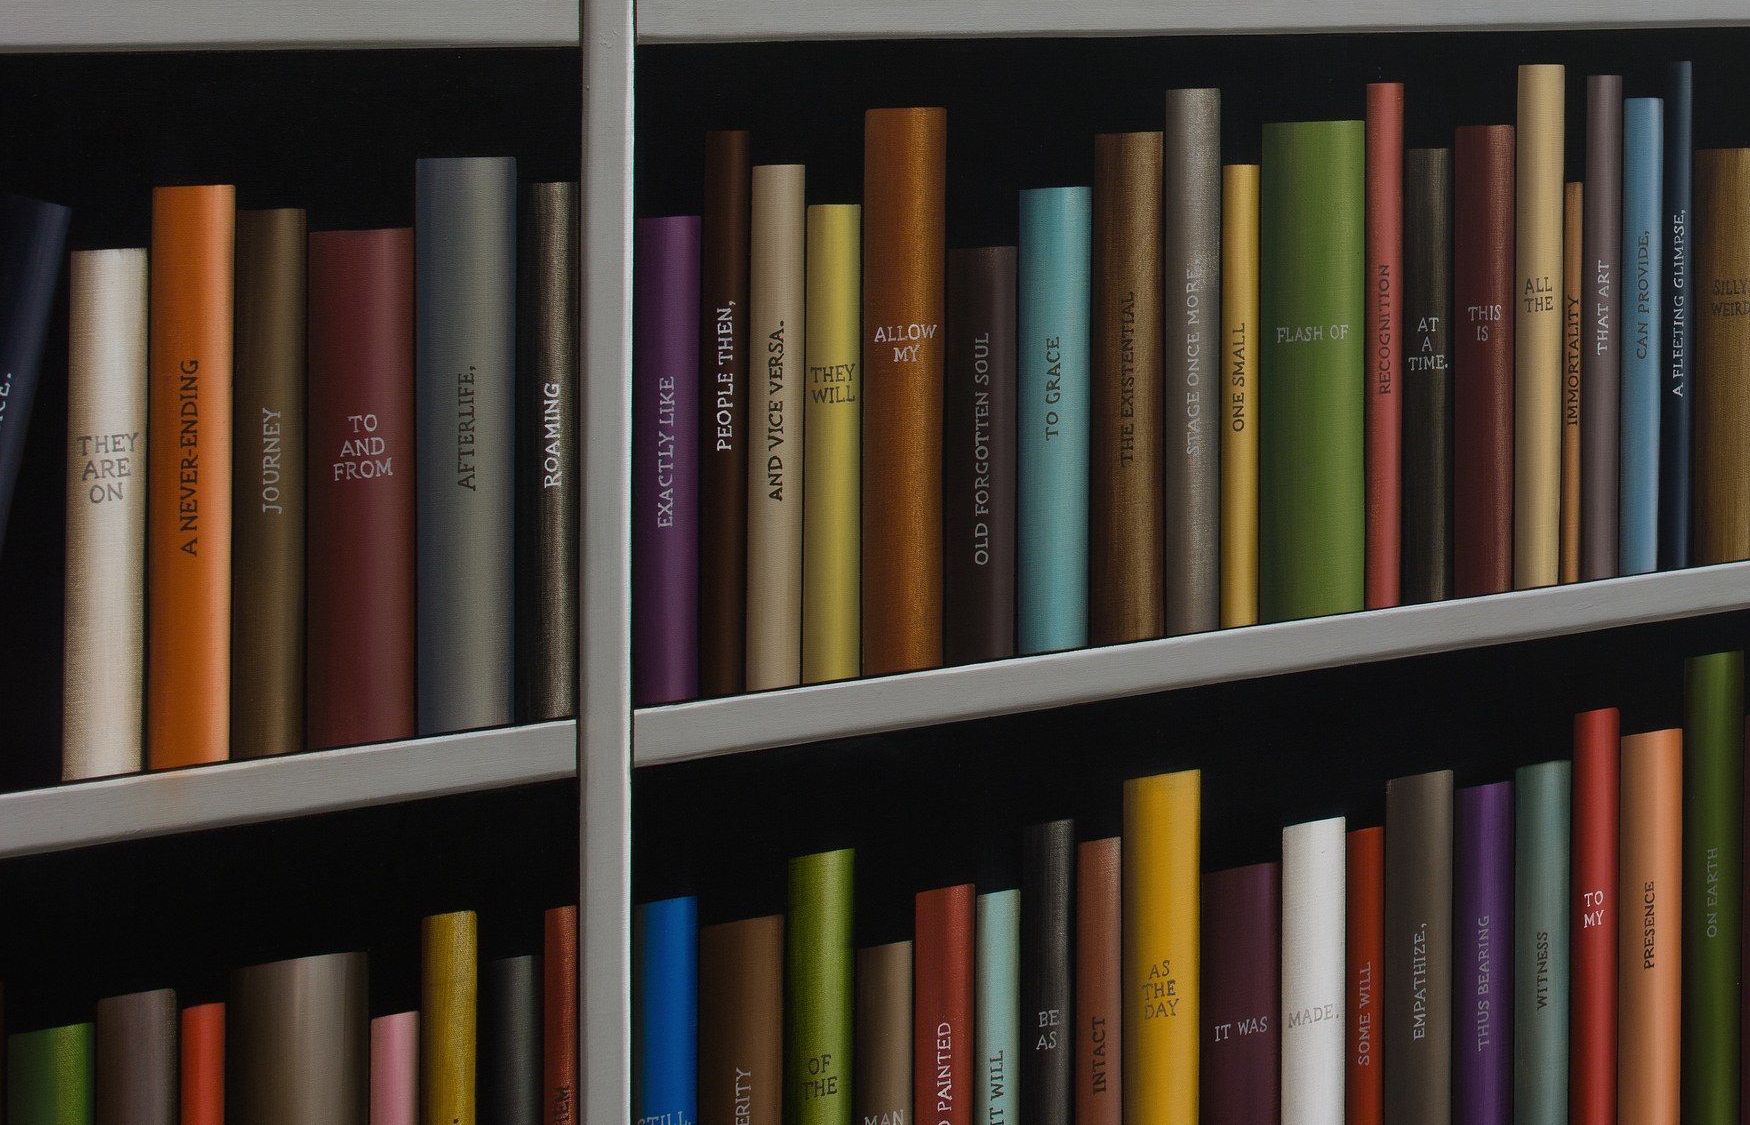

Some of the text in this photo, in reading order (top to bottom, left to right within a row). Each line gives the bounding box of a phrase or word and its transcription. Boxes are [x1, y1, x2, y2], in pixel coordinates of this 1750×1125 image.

[1673, 209, 1686, 397] A FLEETING GLIMPSE,
[874, 324, 936, 343] ALLOW
[893, 345, 920, 362] MY
[717, 300, 735, 451] PEOPLE THEN,
[810, 364, 856, 383] THEY
[811, 385, 856, 404] WILL
[768, 320, 784, 502] AND VICE VERSA.
[348, 414, 378, 433] TO
[457, 365, 477, 491] AFTERLIFE,
[543, 382, 562, 488] ROAMING
[77, 432, 139, 456] THEY
[340, 436, 385, 457] AND
[658, 376, 674, 528] EXACTLY LIKE
[82, 457, 131, 481] ARE
[180, 360, 199, 556] A NEVER-ENDING
[262, 407, 282, 514] JOURNEY
[333, 459, 393, 482] FROM
[90, 482, 124, 504] ON
[1643, 881, 1655, 970] PRESENCE
[1149, 960, 1170, 978] AS
[1142, 979, 1176, 1001] THE
[1413, 923, 1426, 1041] EMPATHIZE,
[1144, 999, 1180, 1021] DAY
[1214, 1017, 1268, 1042] IT WAS
[937, 1023, 951, 1112] PAINTED
